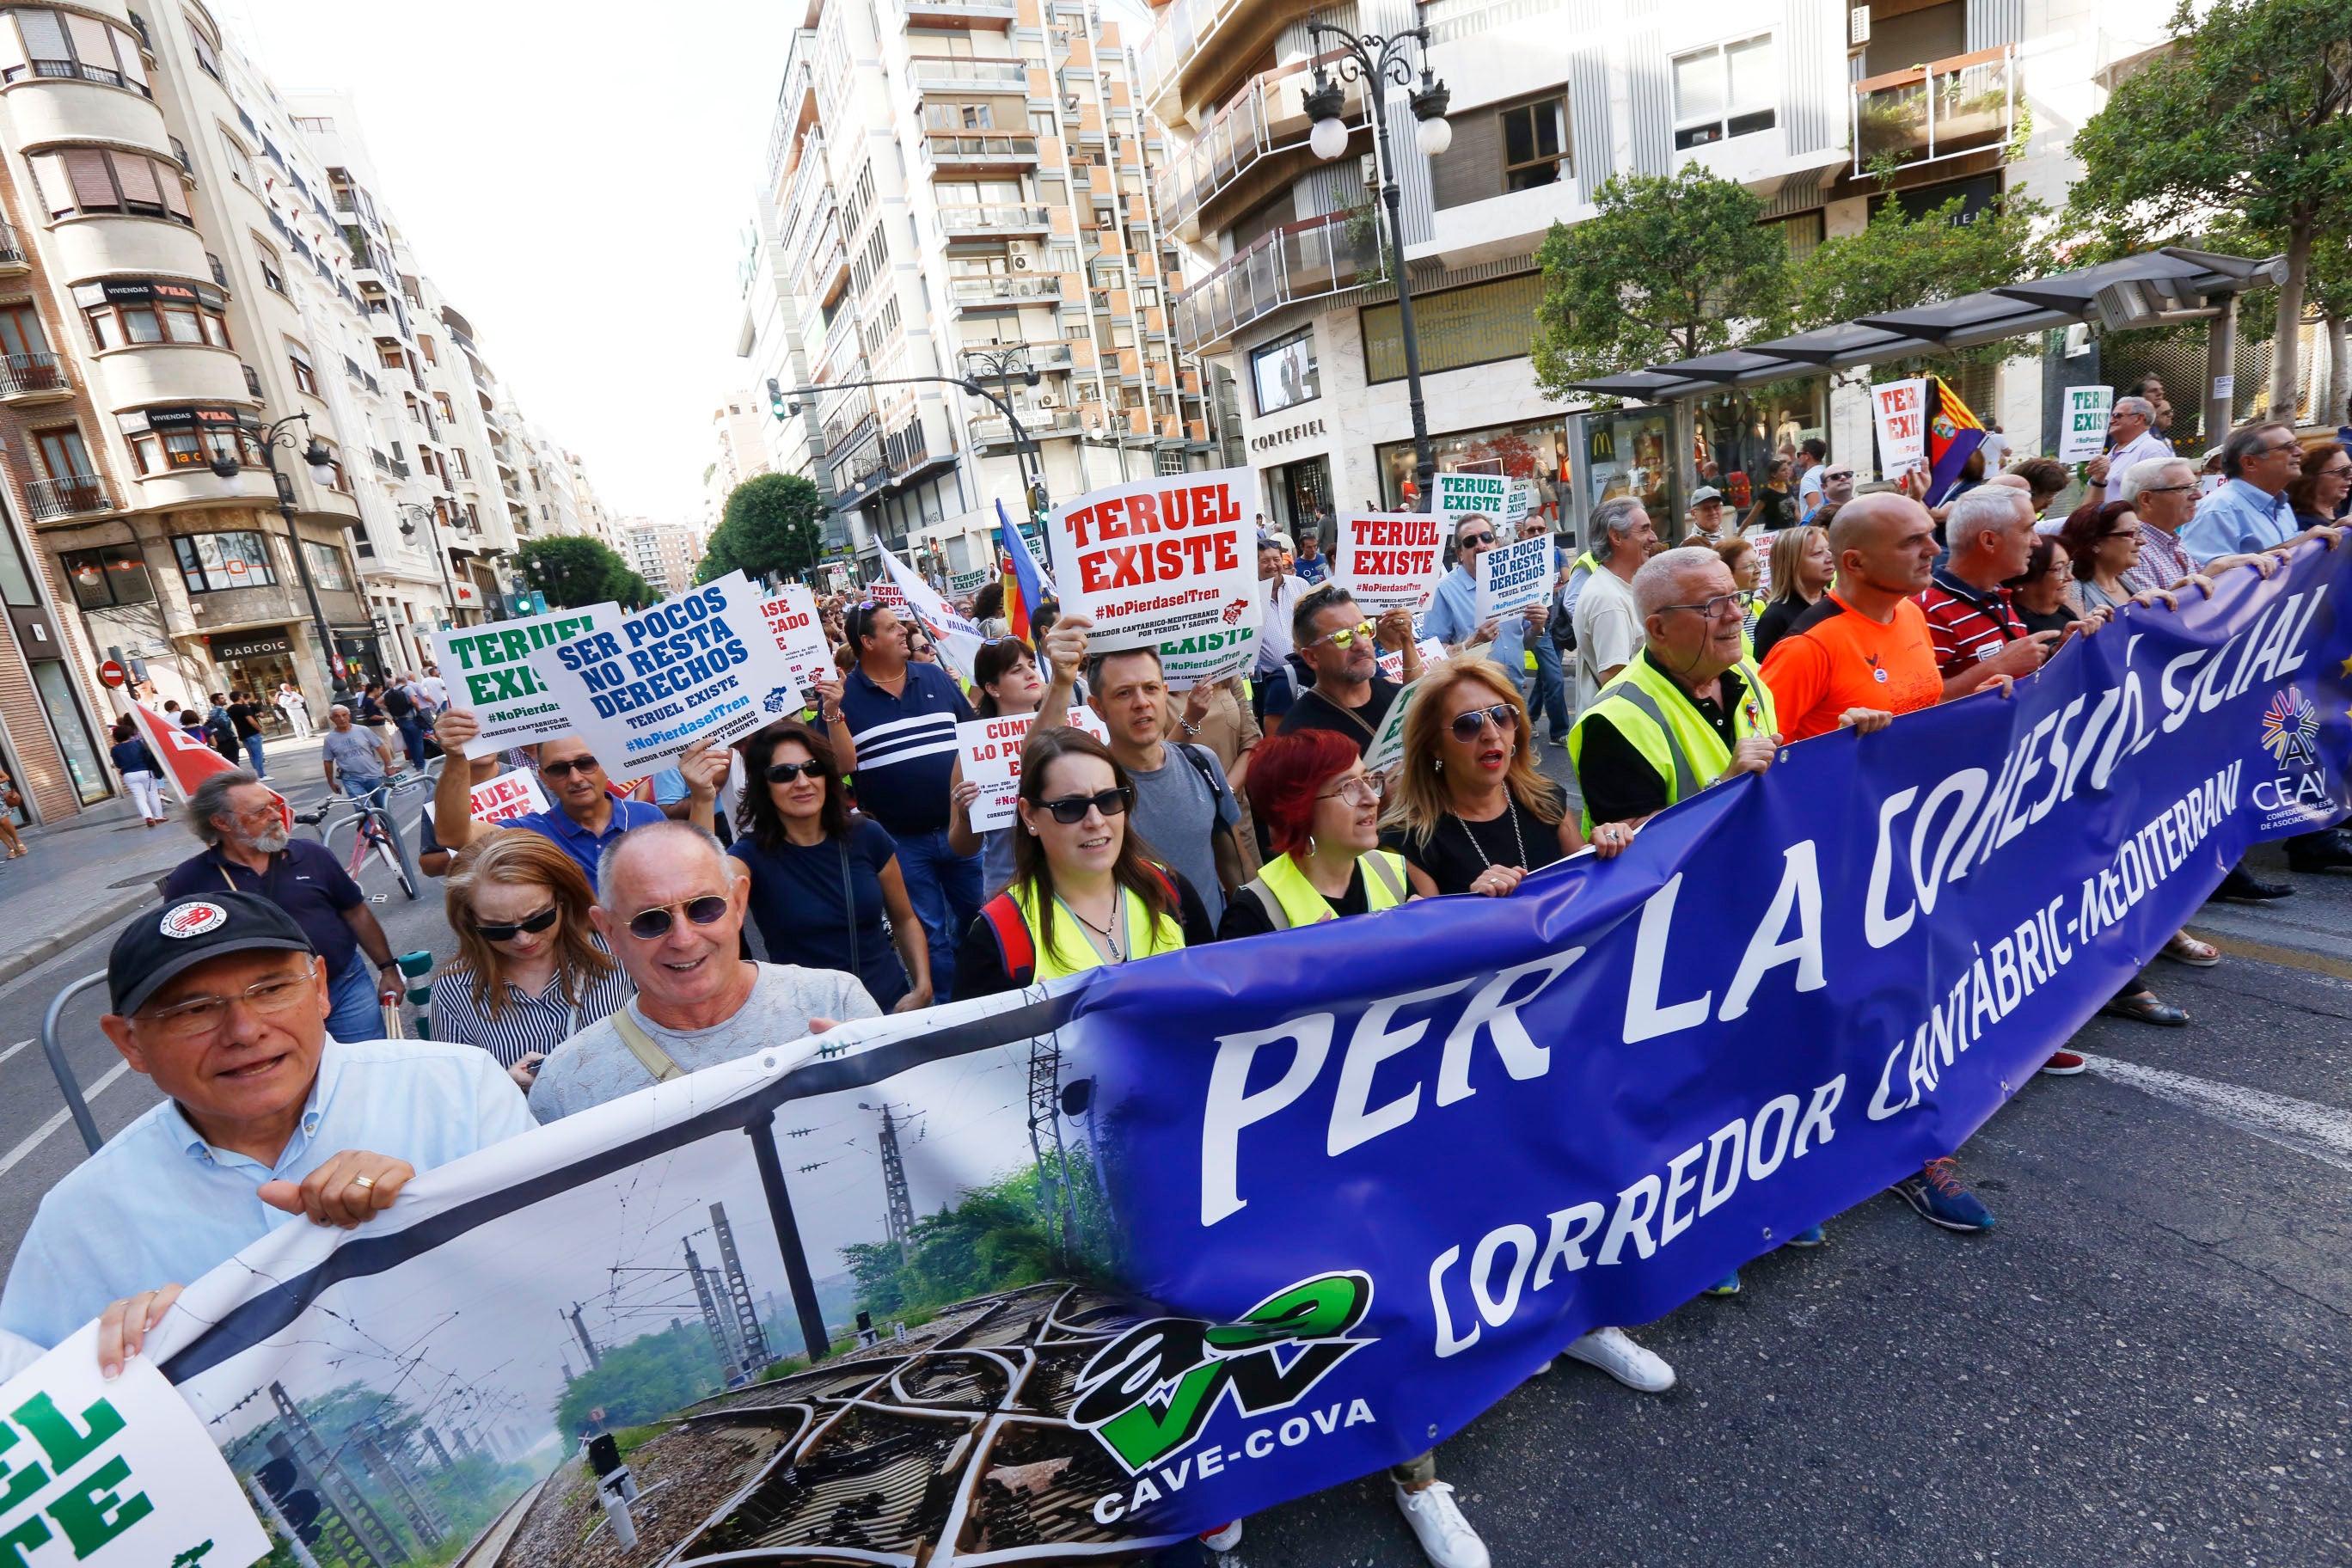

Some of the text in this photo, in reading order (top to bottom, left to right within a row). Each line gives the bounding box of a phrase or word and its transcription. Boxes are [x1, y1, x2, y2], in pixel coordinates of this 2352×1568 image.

[153, 285, 195, 297] VILA
[151, 413, 191, 421] VIVIENDAS
[195, 411, 236, 420] VILA
[1251, 419, 1327, 451] CORTEFIEL
[1442, 477, 1504, 494] TERUEL
[1065, 483, 1240, 548] TERUEL
[1443, 494, 1502, 512] EXISTE
[1351, 520, 1440, 546] TERUEL
[1077, 530, 1239, 594] EXISTE
[1353, 550, 1435, 575] EXISTE
[1488, 537, 1546, 566] SER POCOS
[950, 569, 986, 584] TERUEL
[1490, 564, 1546, 592] DERECHOS
[1491, 551, 1544, 579] NO RESTA
[953, 576, 986, 591] EXISTE
[1356, 583, 1421, 591] #NoPierdaselTren
[1498, 581, 1540, 598] TERUEL EXISTE
[1095, 588, 1220, 620] #NoPierdaselTren
[556, 586, 727, 671] SER POCOS
[1138, 628, 1152, 638] POR
[1154, 625, 1180, 636] TERUEL
[1188, 616, 1219, 628] SAGUNTO
[579, 616, 734, 694] NO RESTA
[1164, 651, 1240, 671] #NoPierdaselTren
[590, 639, 749, 720] DERECHOS
[626, 675, 739, 730] TERUEL EXISTE
[481, 727, 517, 738] CORREDOR
[626, 695, 750, 752] #NoPierdaselTren
[726, 717, 759, 738] SAGUNTO
[623, 753, 659, 769] CORREDOR
[972, 744, 996, 762] LO
[1201, 583, 2329, 1227] PER LA COHESIÓ SOCIAL
[1429, 759, 2243, 1358] CORREDOR CANTÀBRIC-MEDITERRANI
[1093, 1398, 1376, 1525] CAVE-COVA
